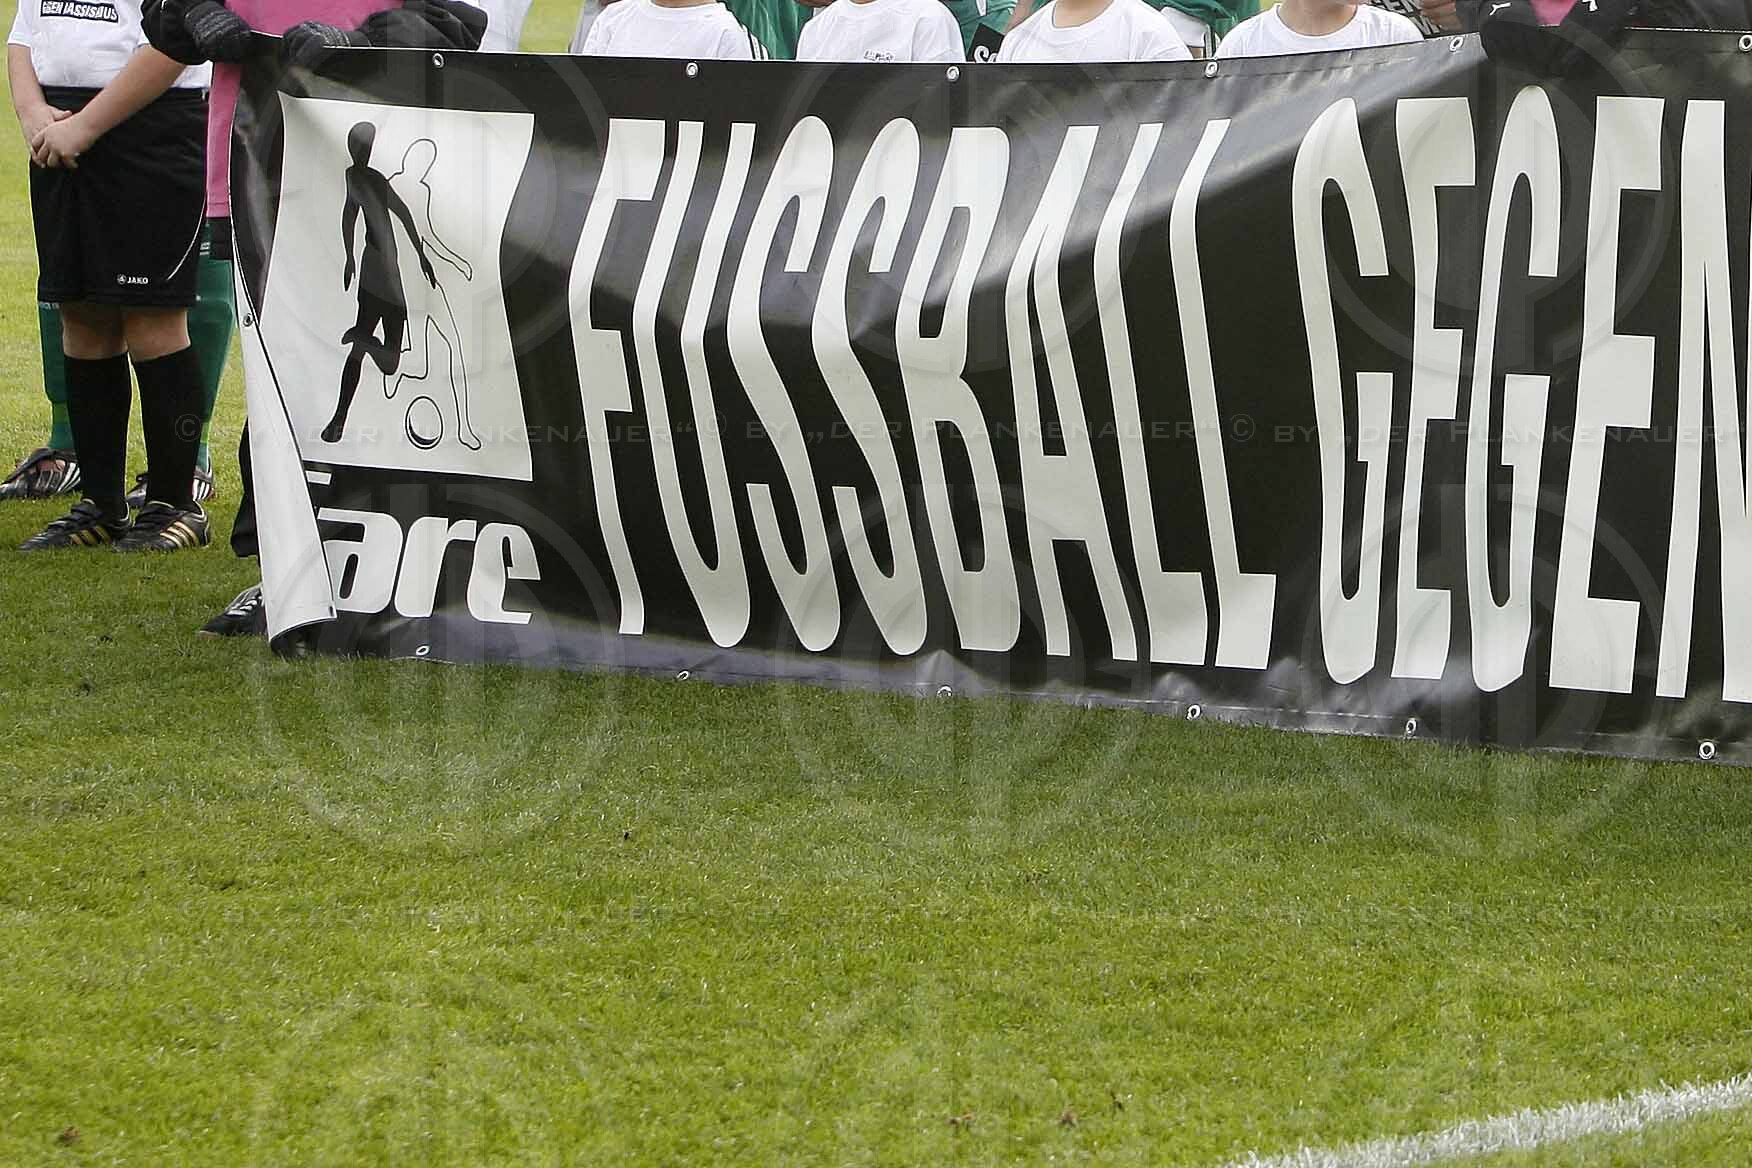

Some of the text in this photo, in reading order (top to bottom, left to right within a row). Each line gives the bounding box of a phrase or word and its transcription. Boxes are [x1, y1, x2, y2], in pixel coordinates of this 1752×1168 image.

[127, 276, 149, 285] JAKO
[569, 116, 1277, 670] FUSSBALL
[306, 470, 542, 625] are
